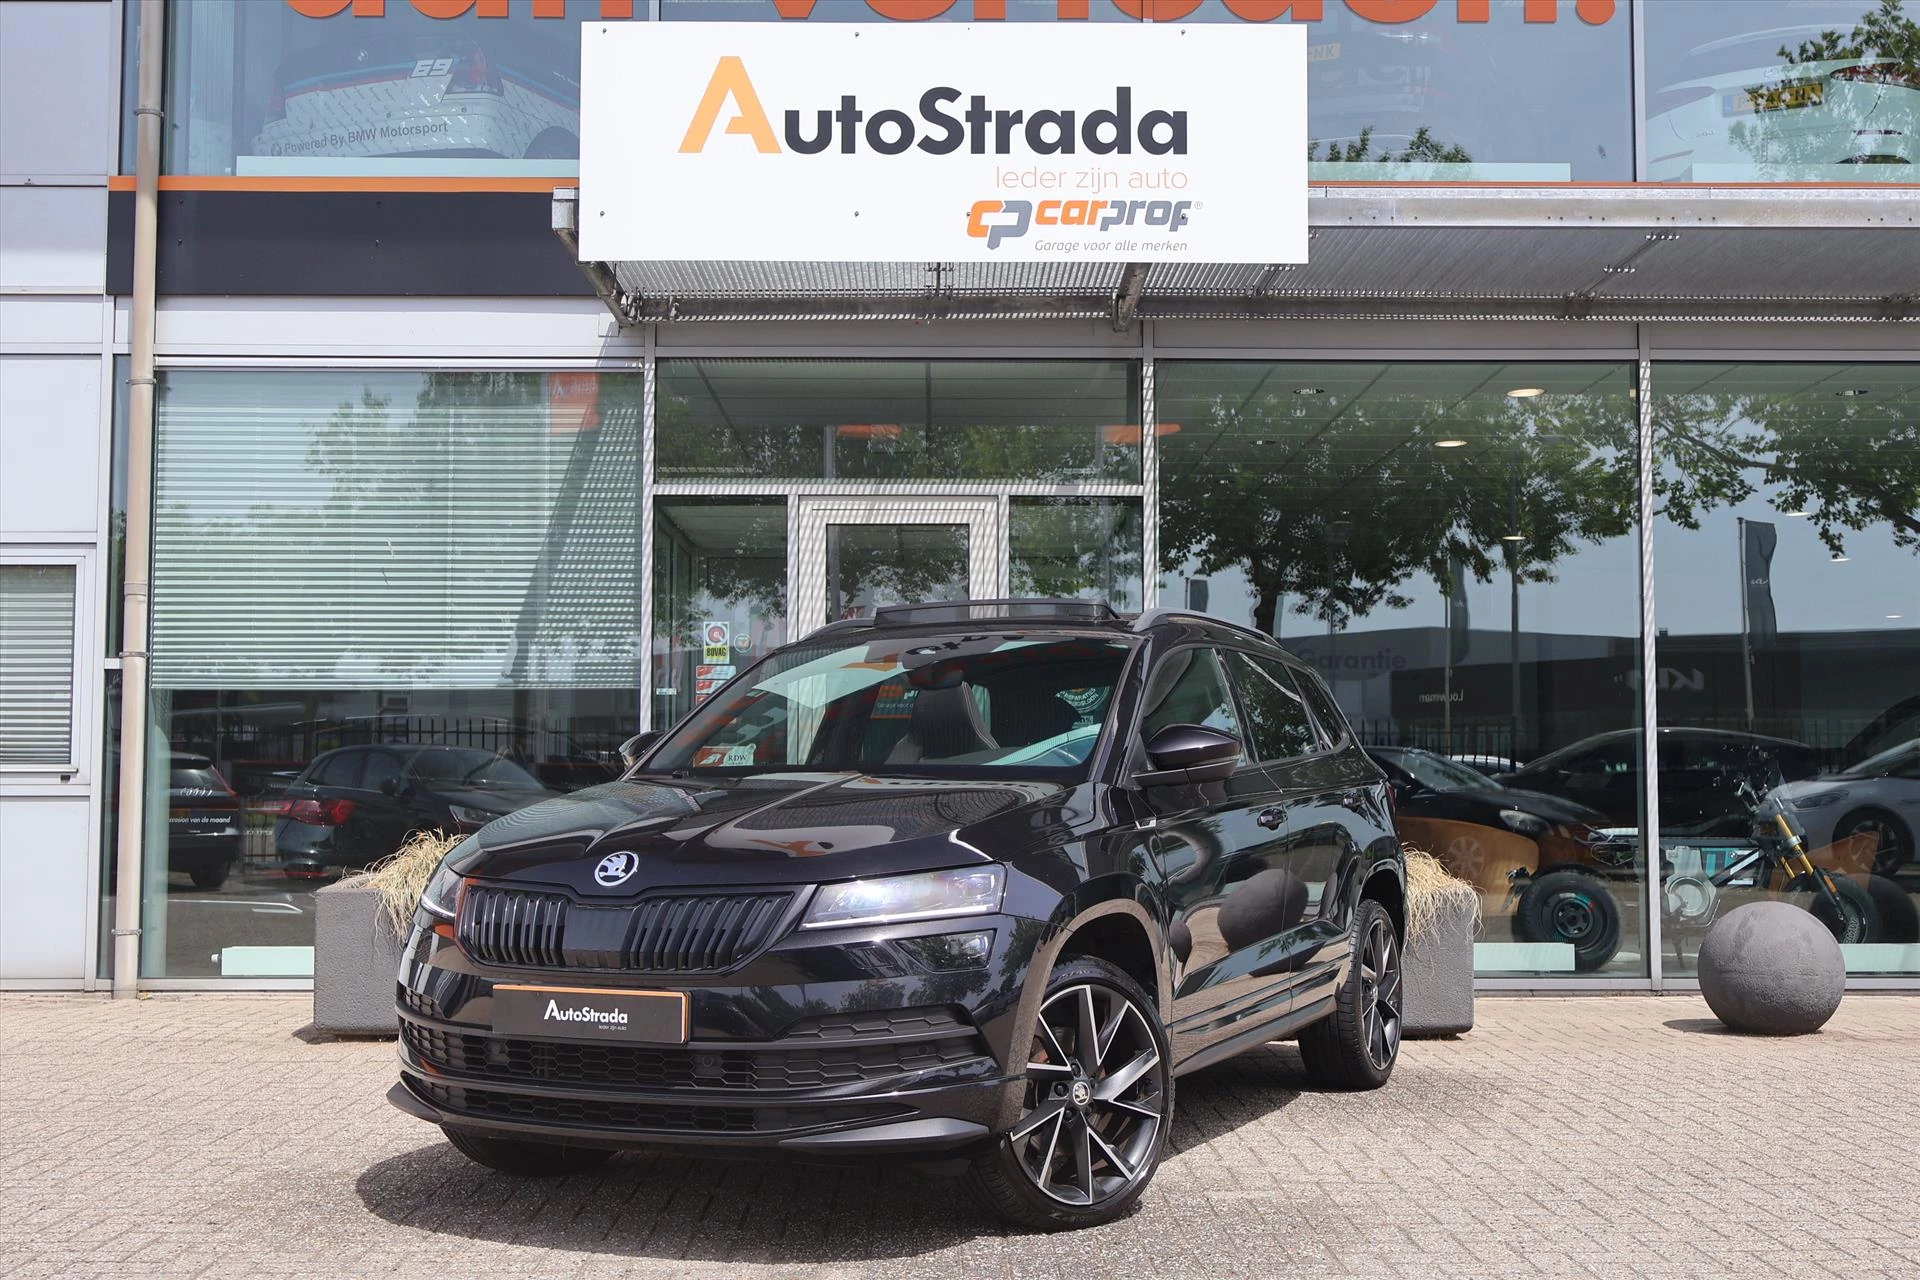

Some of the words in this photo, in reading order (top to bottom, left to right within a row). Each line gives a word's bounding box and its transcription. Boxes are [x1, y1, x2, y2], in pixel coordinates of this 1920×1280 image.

[411, 58, 453, 77] 69
[678, 56, 1187, 155] AutoStrada
[283, 135, 328, 153] Powered
[329, 134, 345, 147] By
[347, 128, 377, 144] BMW
[379, 121, 449, 138] Motorsport
[996, 166, 1067, 189] Ieder
[1075, 167, 1118, 194] zijn
[1128, 168, 1188, 189] auto
[1035, 240, 1079, 253] Garage
[1083, 241, 1111, 251] voor
[1115, 240, 1138, 251] alle
[1141, 240, 1188, 251] merken
[1298, 647, 1407, 672] Garantie
[728, 754, 747, 762] RDW
[544, 999, 628, 1024] AutoStrada
